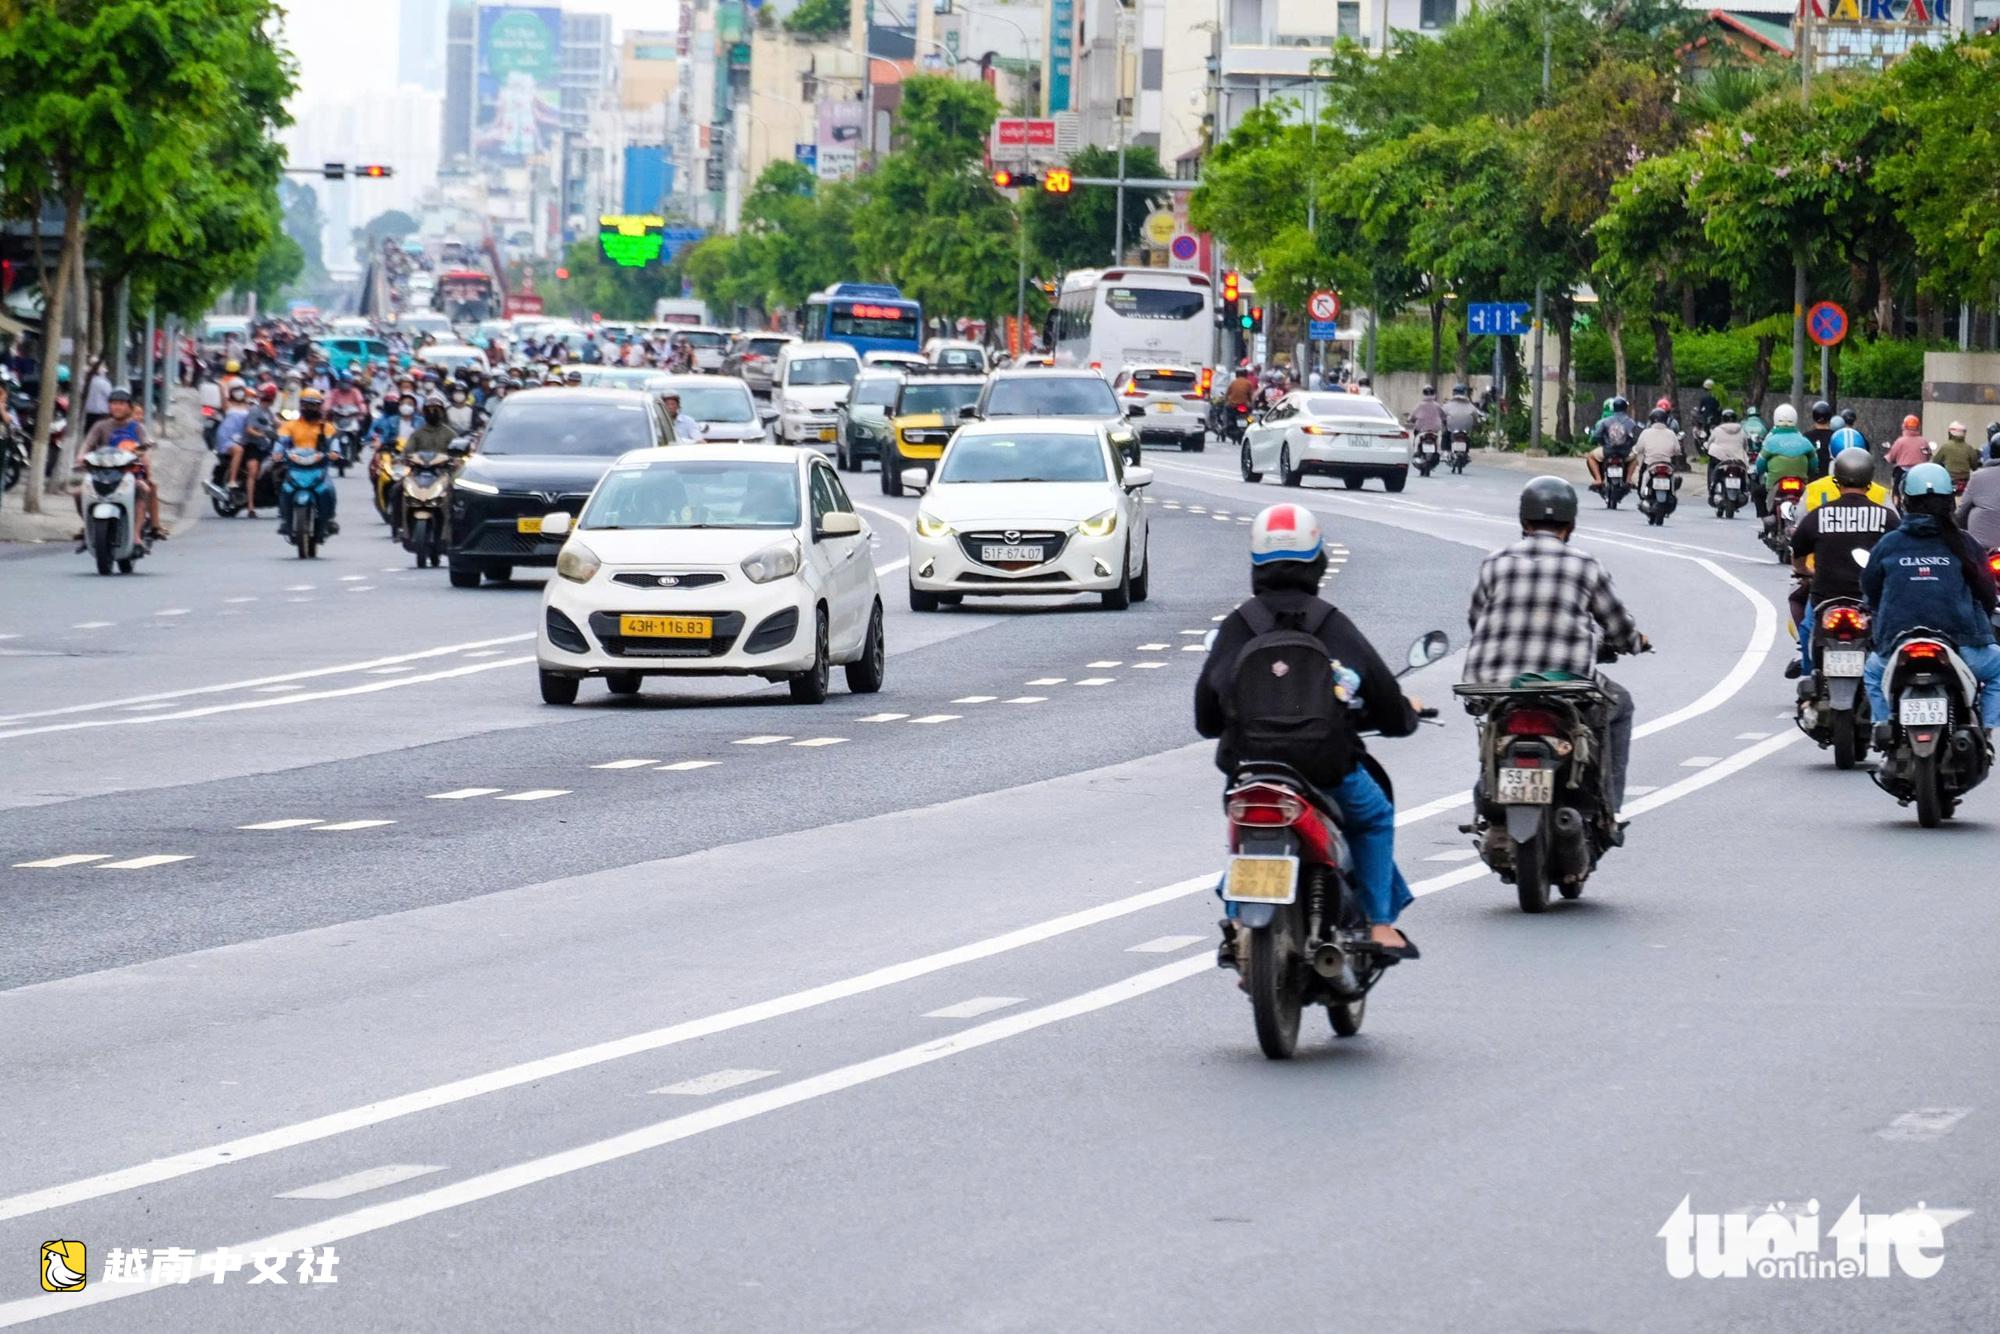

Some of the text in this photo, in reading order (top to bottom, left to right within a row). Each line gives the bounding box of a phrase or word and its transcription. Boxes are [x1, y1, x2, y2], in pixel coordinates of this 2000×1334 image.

[1046, 170, 1070, 192] 20
[1899, 557, 1950, 567] CLASSICS
[660, 576, 677, 585] KIA
[628, 620, 704, 634] 43H-116.83
